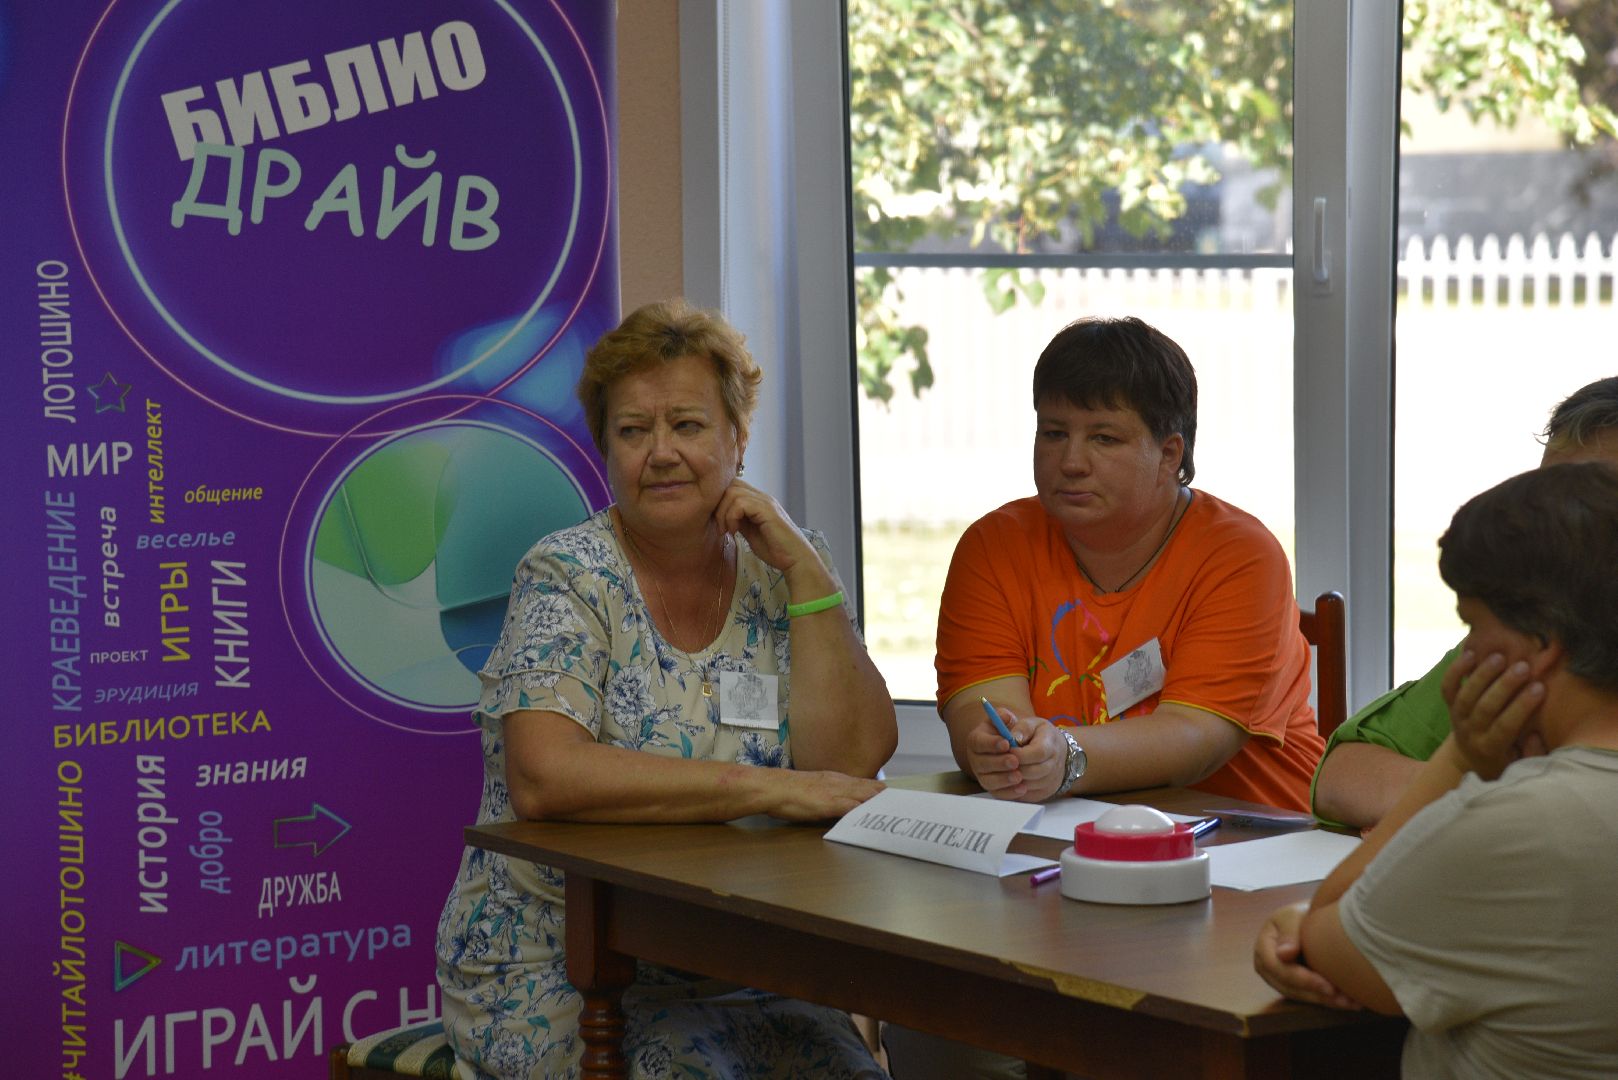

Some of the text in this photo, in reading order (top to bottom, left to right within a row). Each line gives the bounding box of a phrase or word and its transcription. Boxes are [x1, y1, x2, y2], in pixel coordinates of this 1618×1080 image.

[160, 20, 487, 162] БИБЛИО
[171, 142, 500, 251] ДРАЙВ
[36, 260, 76, 423] ЛОТОШИНО
[47, 441, 133, 478] МИР
[146, 398, 165, 524] интеллект
[184, 485, 263, 505] общение
[100, 506, 125, 628] встреча
[136, 530, 236, 550] веселье
[45, 490, 87, 711] КРАЕВЕДЕНИЕ
[159, 561, 191, 662] ИГРЫ
[211, 560, 250, 688] КНИГИ
[90, 649, 149, 664] ПРОЕКТ
[94, 682, 199, 704] ЭРУДИЦИЯ
[53, 709, 272, 749] БИБЛИОТЕКА
[195, 756, 308, 787] знания
[189, 810, 232, 894] добро
[854, 812, 995, 854] МЫСЛИТЕЛИ
[258, 871, 342, 918] ДРУЖБА
[175, 923, 412, 969] литература
[114, 974, 436, 1080] ИГРАЙ С Н
